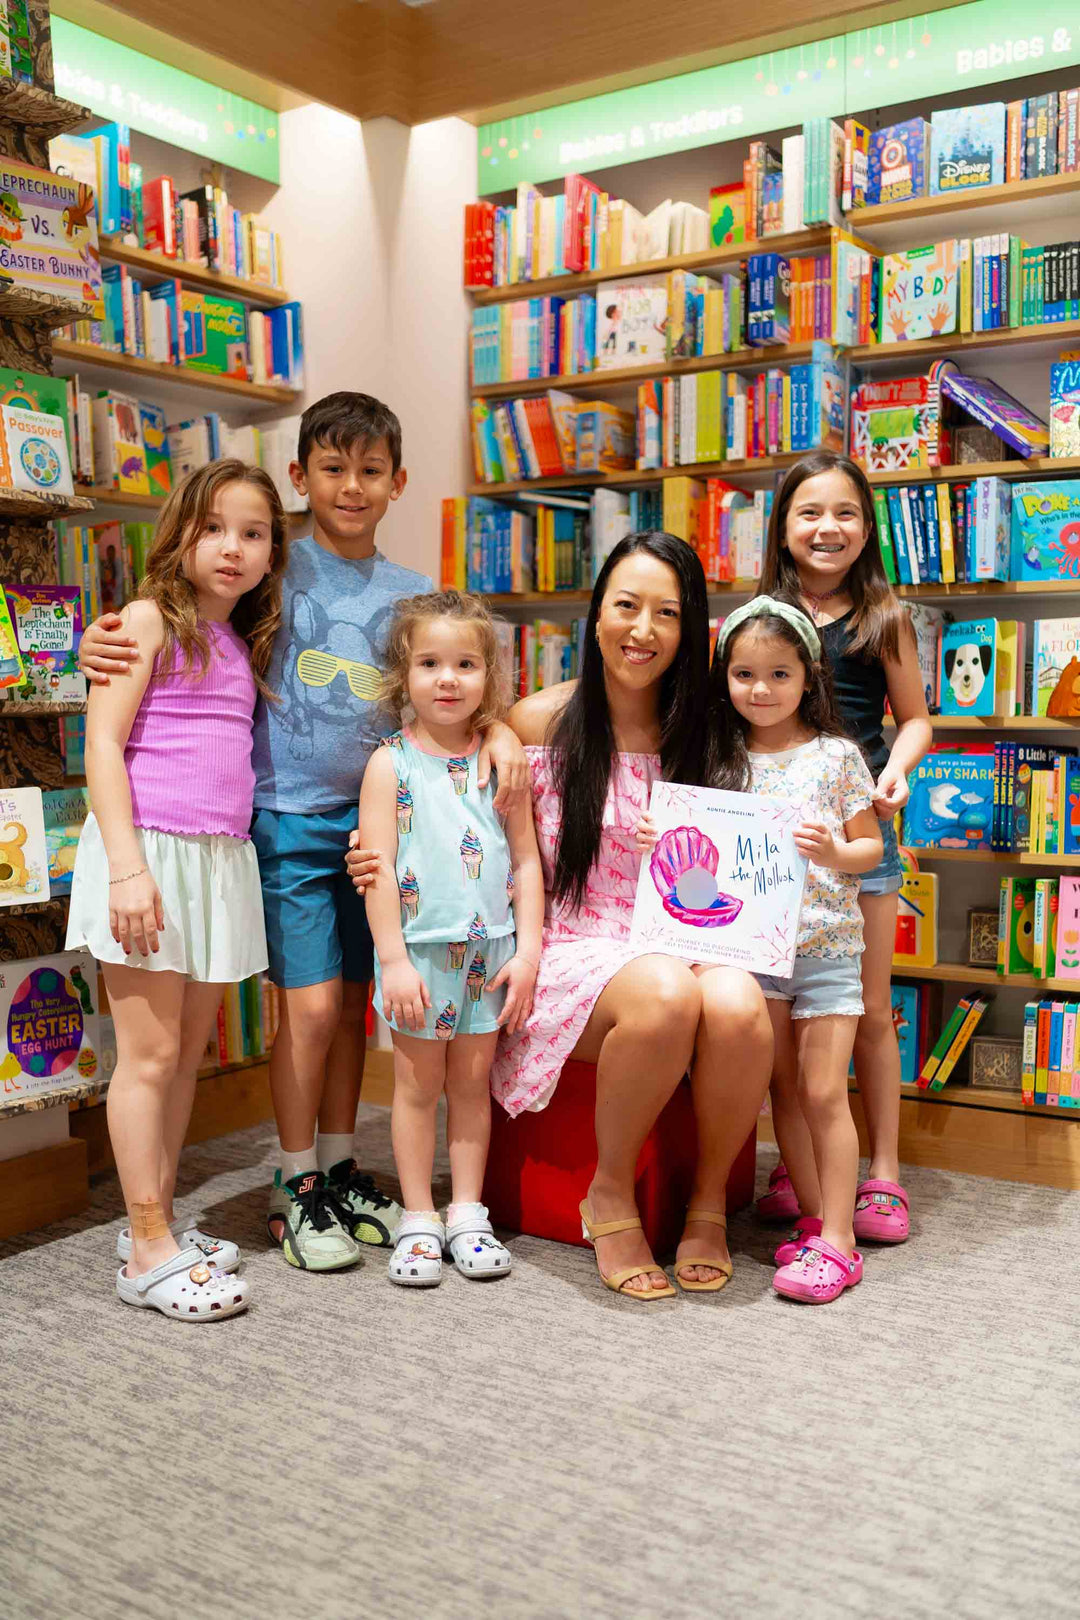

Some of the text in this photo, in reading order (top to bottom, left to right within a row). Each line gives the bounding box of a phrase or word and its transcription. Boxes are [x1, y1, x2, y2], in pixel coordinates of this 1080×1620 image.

[956, 27, 1073, 75] Babies &
[31, 214, 55, 237] VS.
[0, 249, 90, 279] EASTER BUNNY
[887, 280, 909, 309] MY
[914, 275, 954, 299] BODY
[9, 416, 64, 439] Passover
[18, 616, 73, 630] Leprechaun
[32, 607, 50, 618] The
[35, 629, 68, 643] Finally
[40, 641, 65, 650] Gone!
[980, 633, 992, 644] Dog
[1018, 748, 1025, 760] 8
[1026, 748, 1047, 761] Little
[918, 766, 995, 781] BABY SHARK
[706, 806, 755, 817] AUNTIE ANGELINE
[736, 833, 781, 867] Mila
[729, 862, 795, 897] the Mollusk
[11, 1014, 82, 1044] EASTER
[22, 1035, 74, 1056] EGG HUNT
